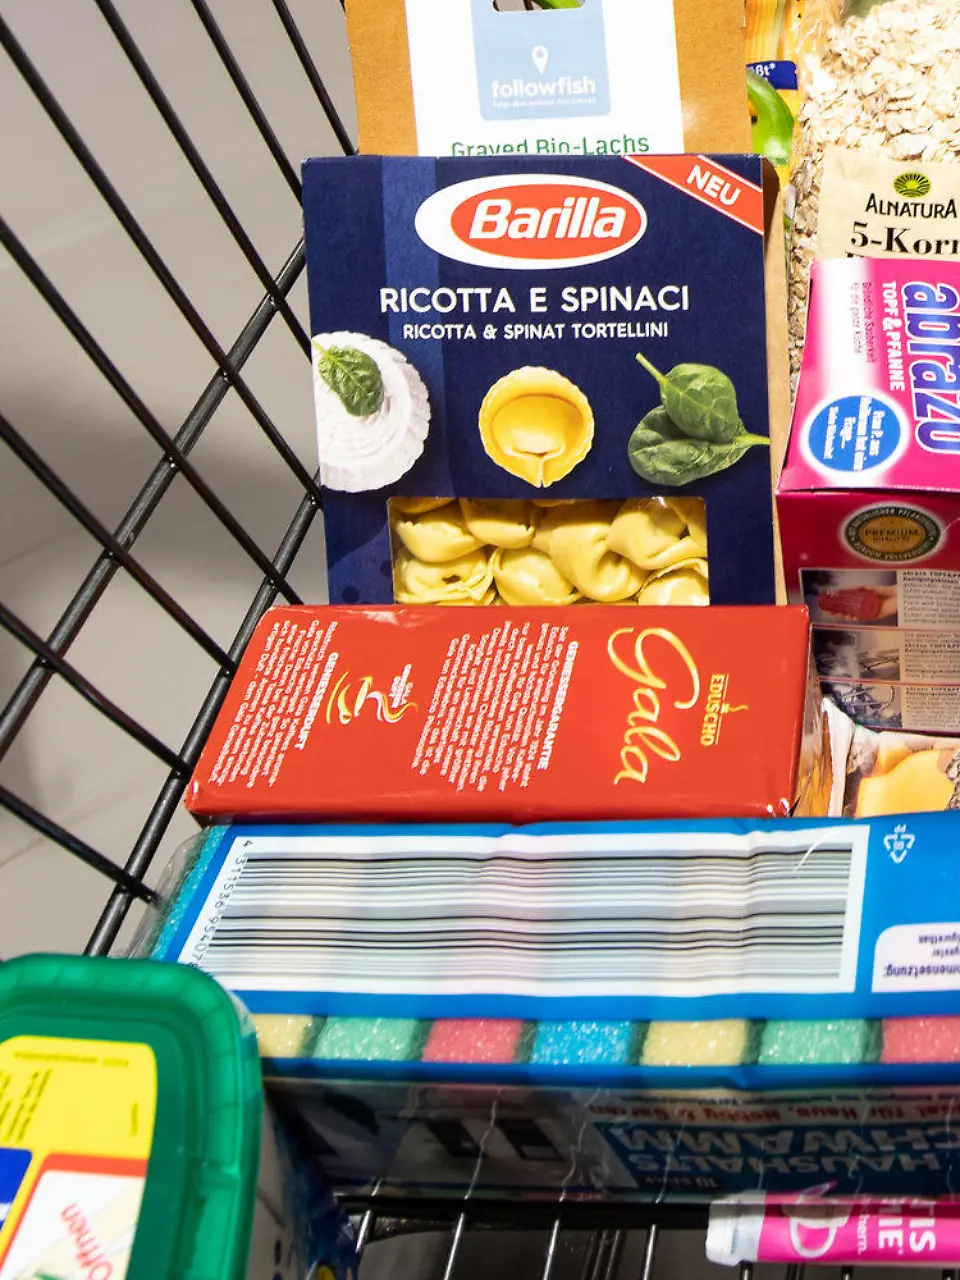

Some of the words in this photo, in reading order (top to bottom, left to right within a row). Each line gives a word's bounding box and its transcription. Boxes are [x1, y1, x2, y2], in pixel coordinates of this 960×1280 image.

[491, 75, 596, 99] followfish
[535, 134, 650, 155] Bio-Lachs
[686, 164, 742, 207] NEU
[469, 196, 627, 240] Barilla
[864, 192, 958, 219] ALNATURA
[380, 287, 516, 313] RICOTTA
[530, 287, 548, 312] E
[561, 285, 690, 312] SPINACI
[403, 324, 476, 339] RICOTTA
[483, 324, 496, 339] &
[504, 323, 564, 339] SPINAT
[572, 322, 668, 339] TORTELLINI
[607, 626, 701, 784] Gala
[700, 674, 725, 746] EDUSCHO
